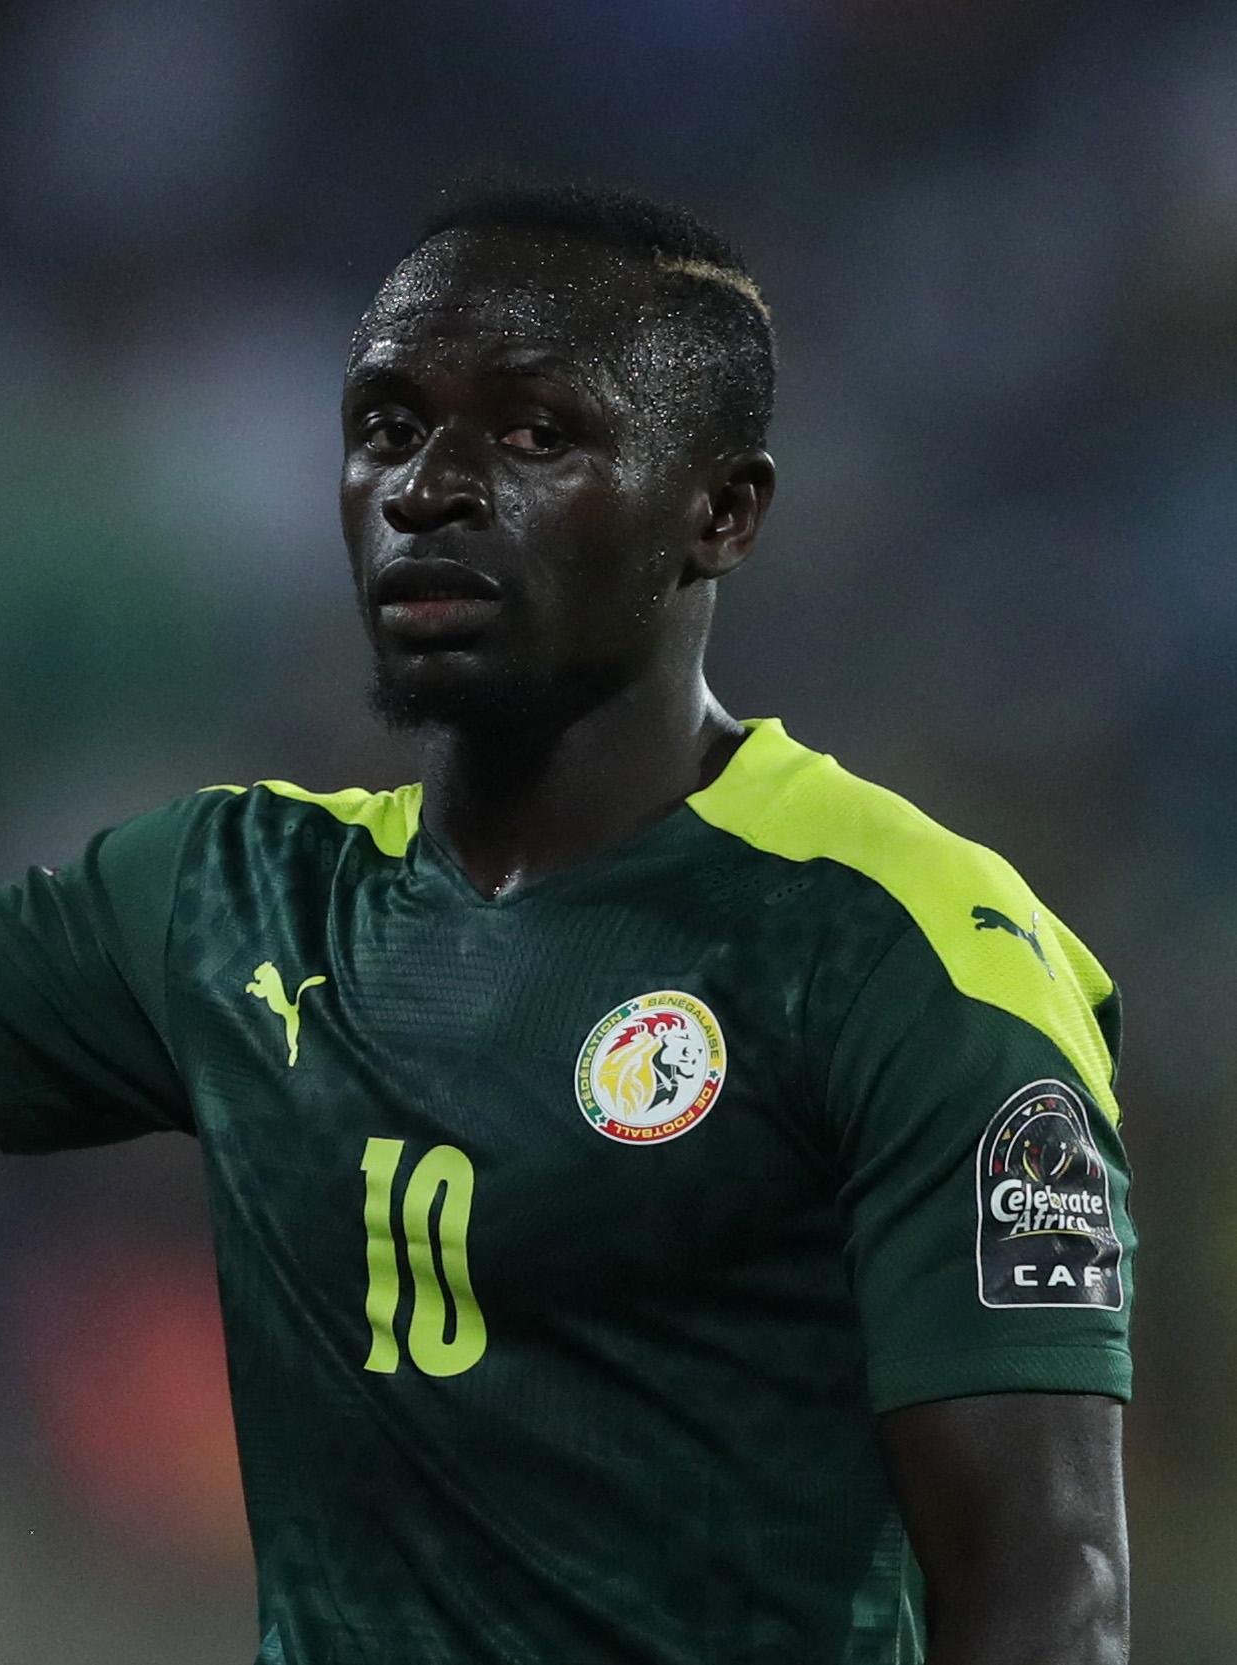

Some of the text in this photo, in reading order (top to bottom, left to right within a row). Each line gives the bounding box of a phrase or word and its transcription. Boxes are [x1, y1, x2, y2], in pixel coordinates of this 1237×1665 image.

[693, 1089, 714, 1110] DE
[614, 1108, 696, 1139] FOOTBALL
[990, 1179, 1104, 1223] Celebrate
[1010, 1210, 1092, 1235] Africa
[360, 1137, 488, 1377] 10
[1013, 1264, 1103, 1288] CAF
